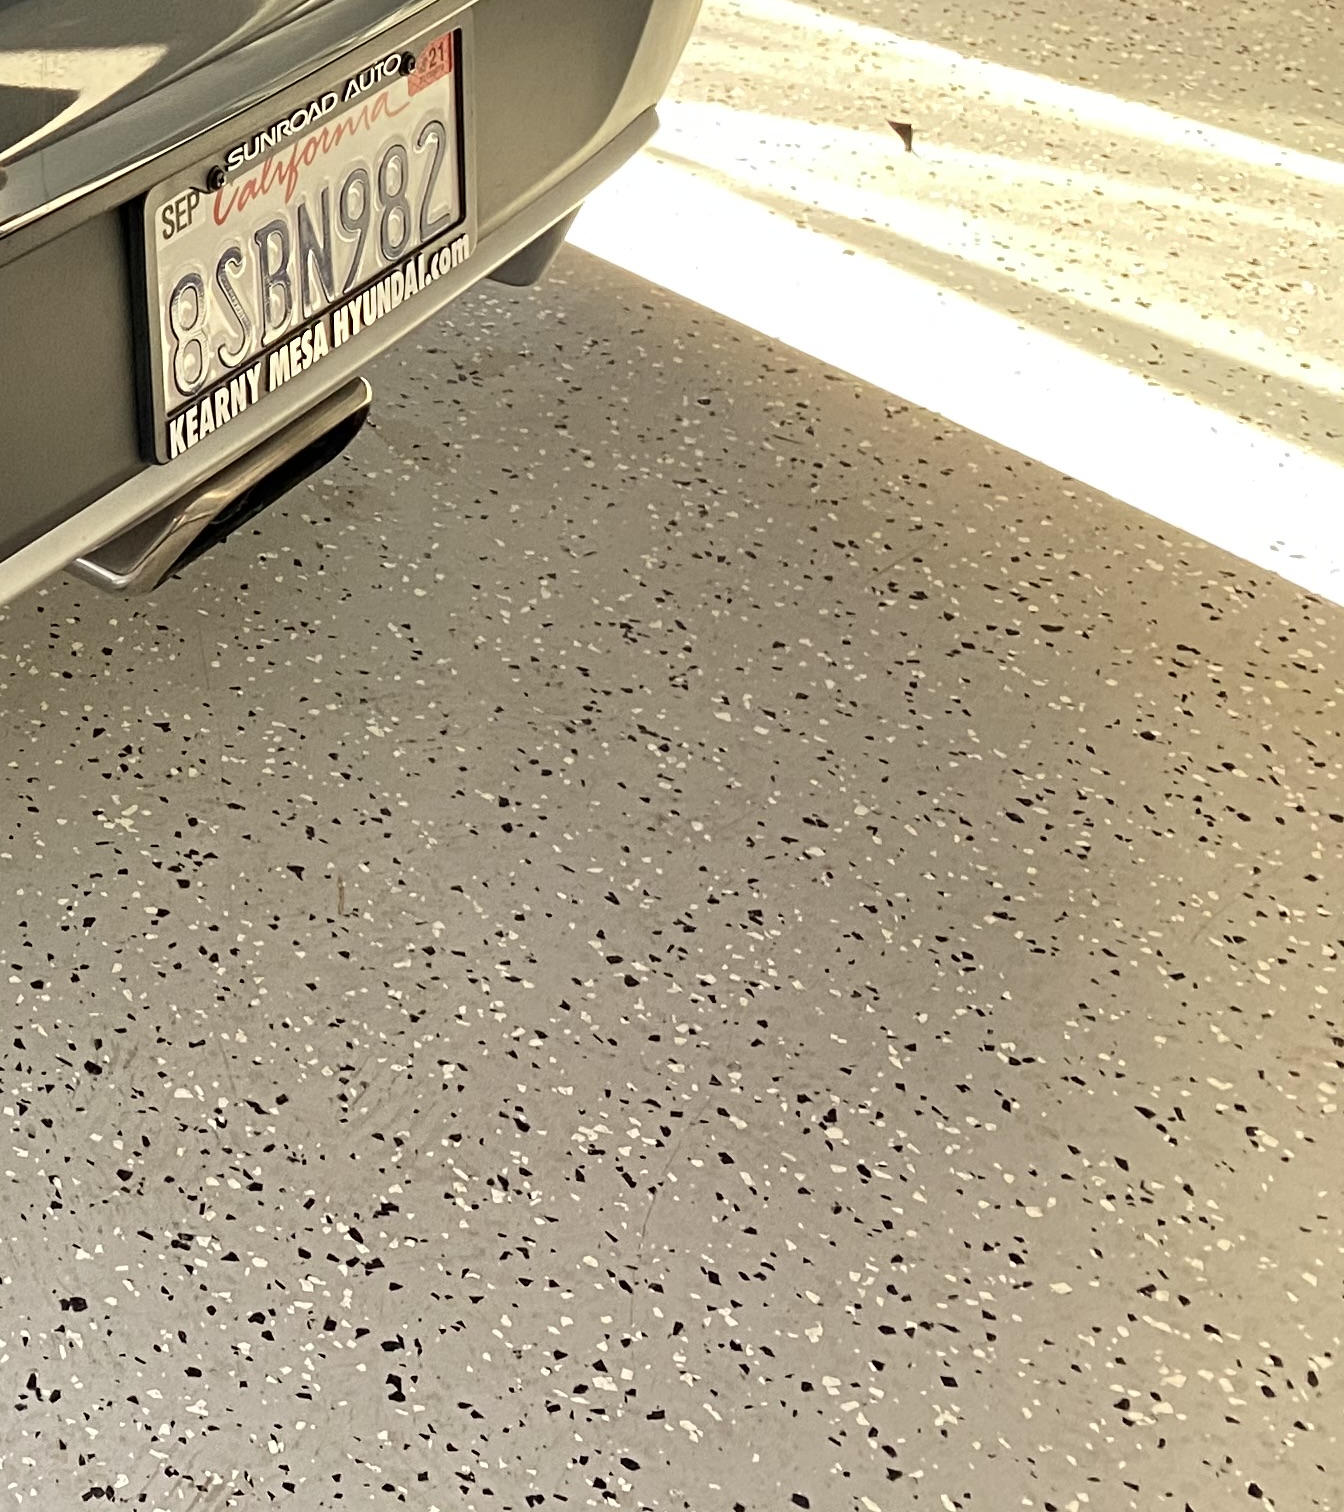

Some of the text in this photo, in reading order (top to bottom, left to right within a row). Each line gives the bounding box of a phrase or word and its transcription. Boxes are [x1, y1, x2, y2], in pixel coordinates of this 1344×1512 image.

[212, 90, 411, 226] California
[226, 91, 339, 172] SUNROAD
[344, 53, 402, 102] AUTO
[161, 189, 201, 240] SEP
[169, 118, 452, 397] 8SBN982
[169, 233, 471, 460] KEARNY MESA HYUNDAI.com
